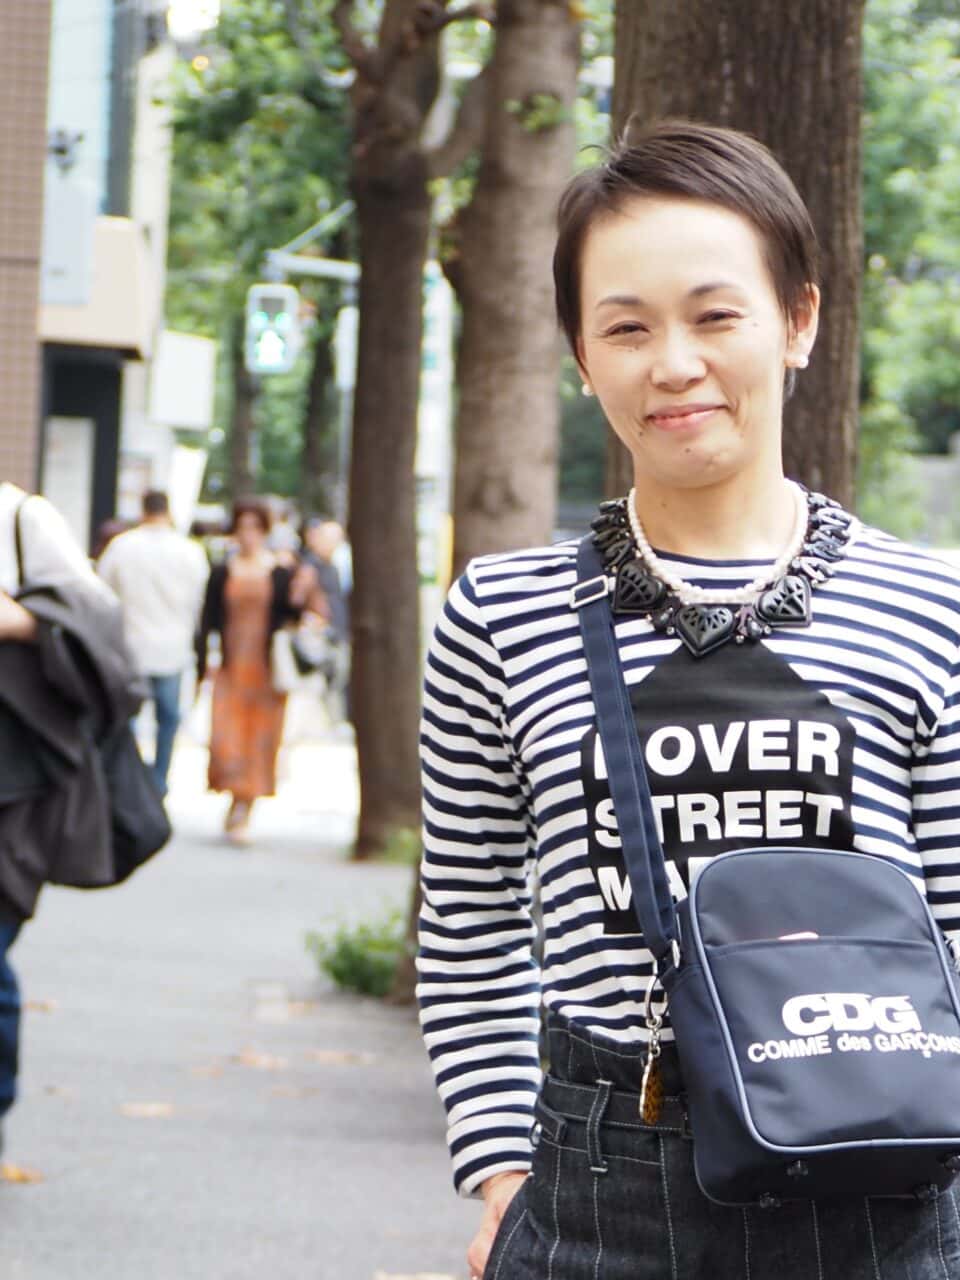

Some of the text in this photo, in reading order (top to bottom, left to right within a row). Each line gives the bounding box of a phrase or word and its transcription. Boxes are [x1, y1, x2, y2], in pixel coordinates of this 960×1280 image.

[594, 719, 841, 780] OVER
[781, 992, 922, 1036] CDG
[747, 1034, 832, 1063] COMME
[836, 1031, 873, 1052] des
